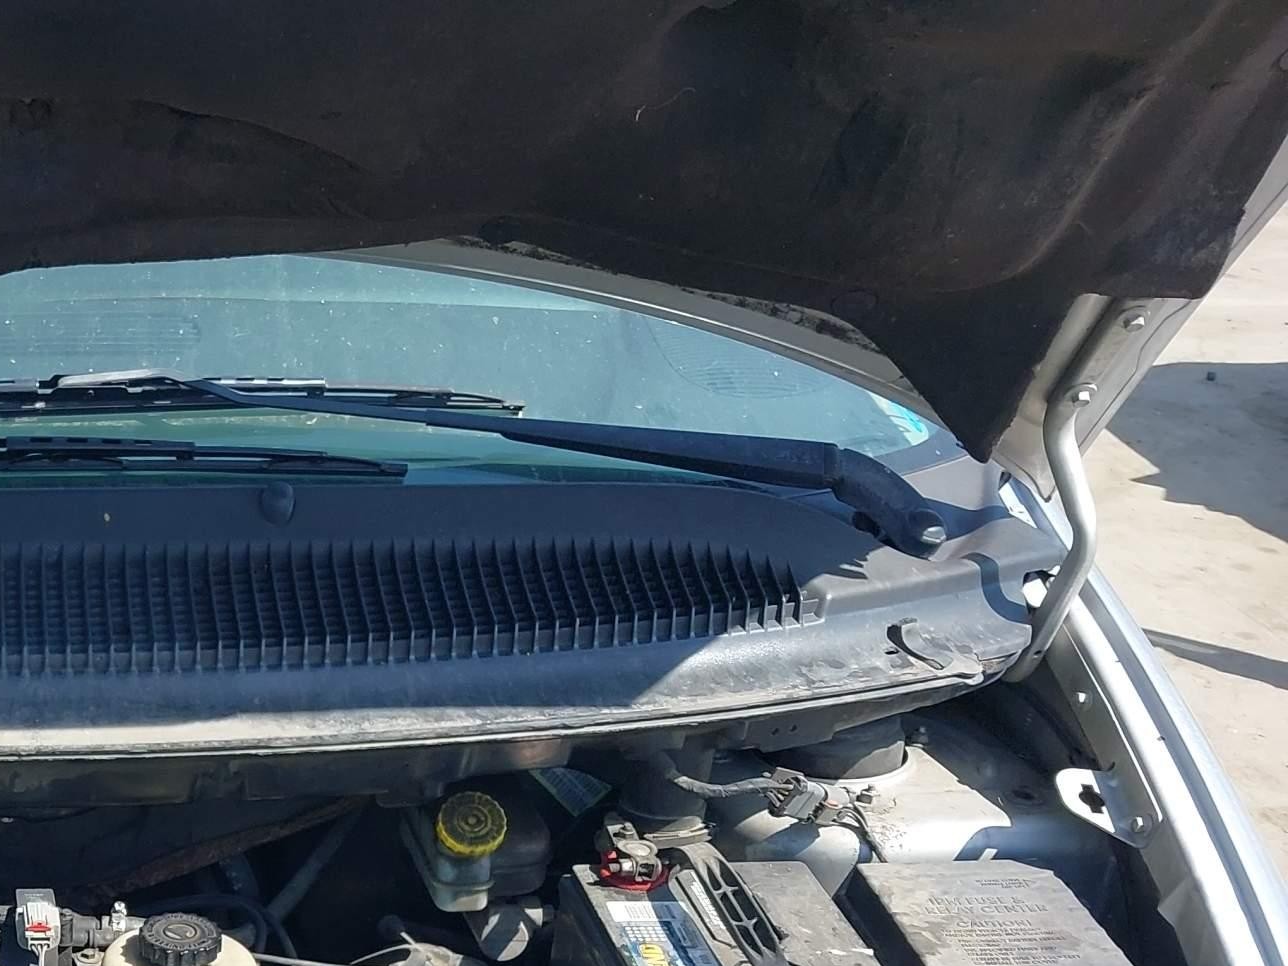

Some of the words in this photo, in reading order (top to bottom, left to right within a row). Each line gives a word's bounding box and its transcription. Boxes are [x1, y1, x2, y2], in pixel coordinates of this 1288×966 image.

[964, 895, 1008, 905] FUSE
[980, 904, 1048, 915] CENTER
[956, 919, 1033, 929] CAUTION!
